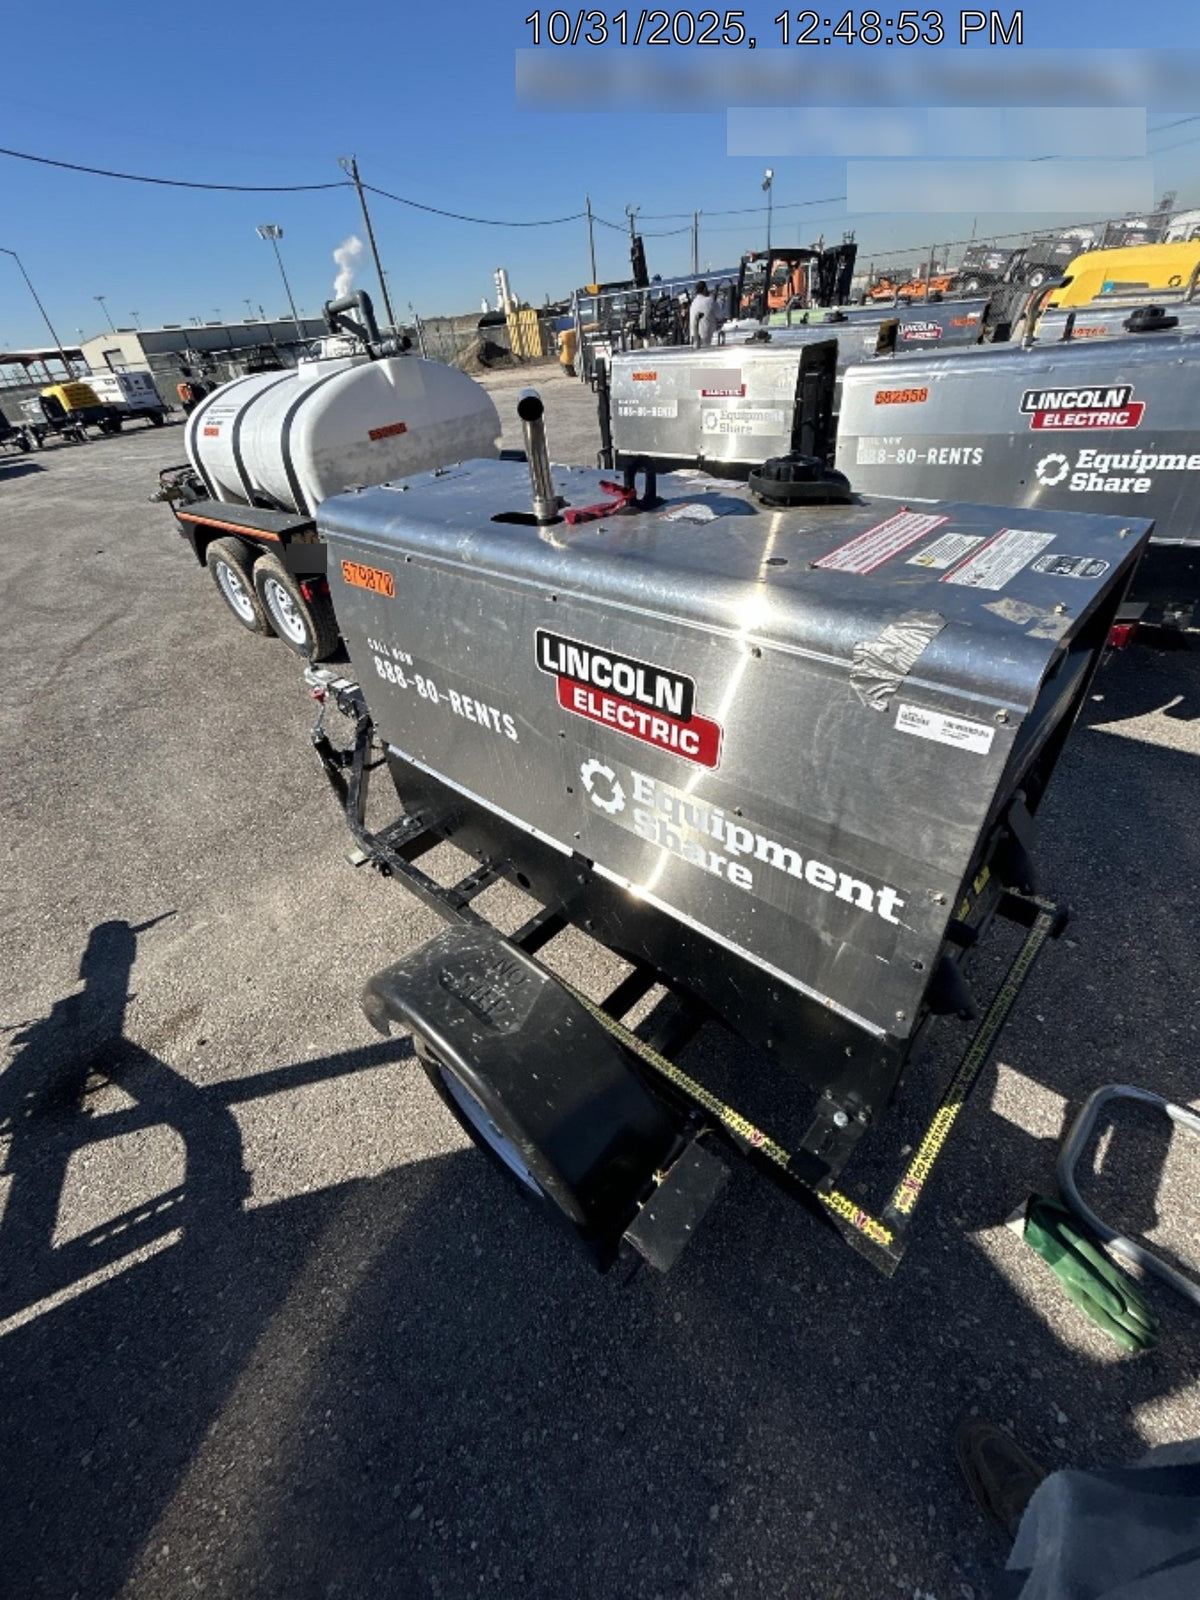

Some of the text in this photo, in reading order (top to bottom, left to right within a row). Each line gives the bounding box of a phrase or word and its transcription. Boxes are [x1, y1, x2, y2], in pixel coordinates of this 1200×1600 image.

[719, 423, 753, 433] Share
[1026, 388, 1126, 410] LINCOLN
[1042, 411, 1130, 427] ELECTRIC
[1068, 472, 1152, 494] Share
[374, 655, 518, 742] 888-80-RENTS
[541, 637, 685, 716] LINCOLN
[573, 687, 700, 755] ELECTRIC
[629, 769, 905, 926] Equipment
[632, 806, 753, 891] Share
[911, 1109, 952, 1180] DO NOT STAND
